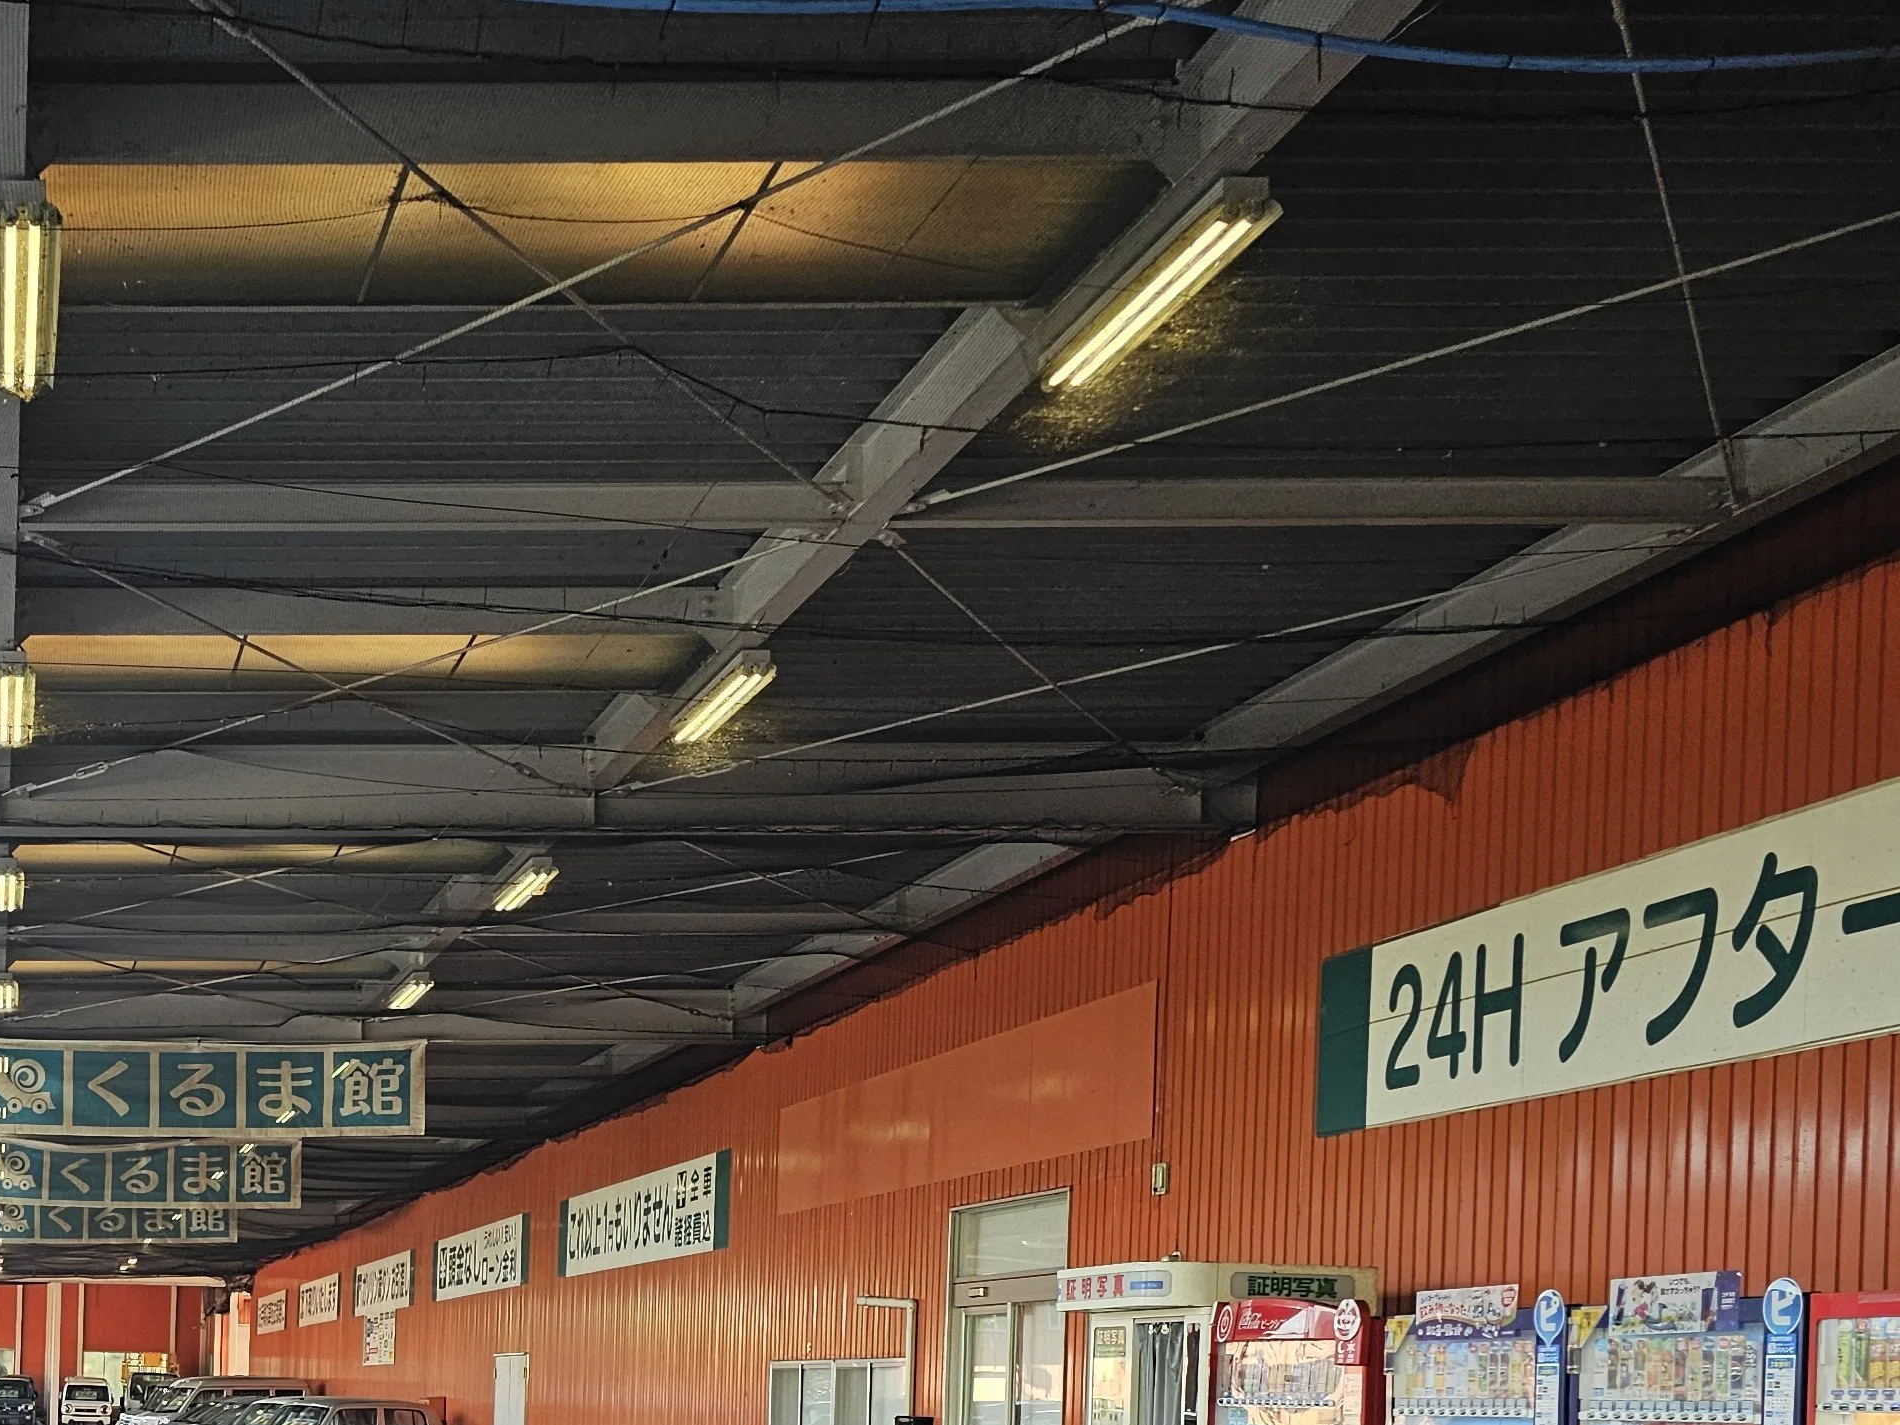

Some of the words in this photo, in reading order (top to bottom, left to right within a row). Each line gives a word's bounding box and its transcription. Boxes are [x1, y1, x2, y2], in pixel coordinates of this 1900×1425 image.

[1385, 932, 1526, 1090] 24H
[87, 1058, 406, 1119] くるま館
[59, 1151, 286, 1195] くるま館
[690, 1166, 712, 1202] 全車
[674, 1210, 711, 1247] 諸経費込
[1066, 1274, 1124, 1300] 証明写真
[1248, 1275, 1338, 1297] 証明写真
